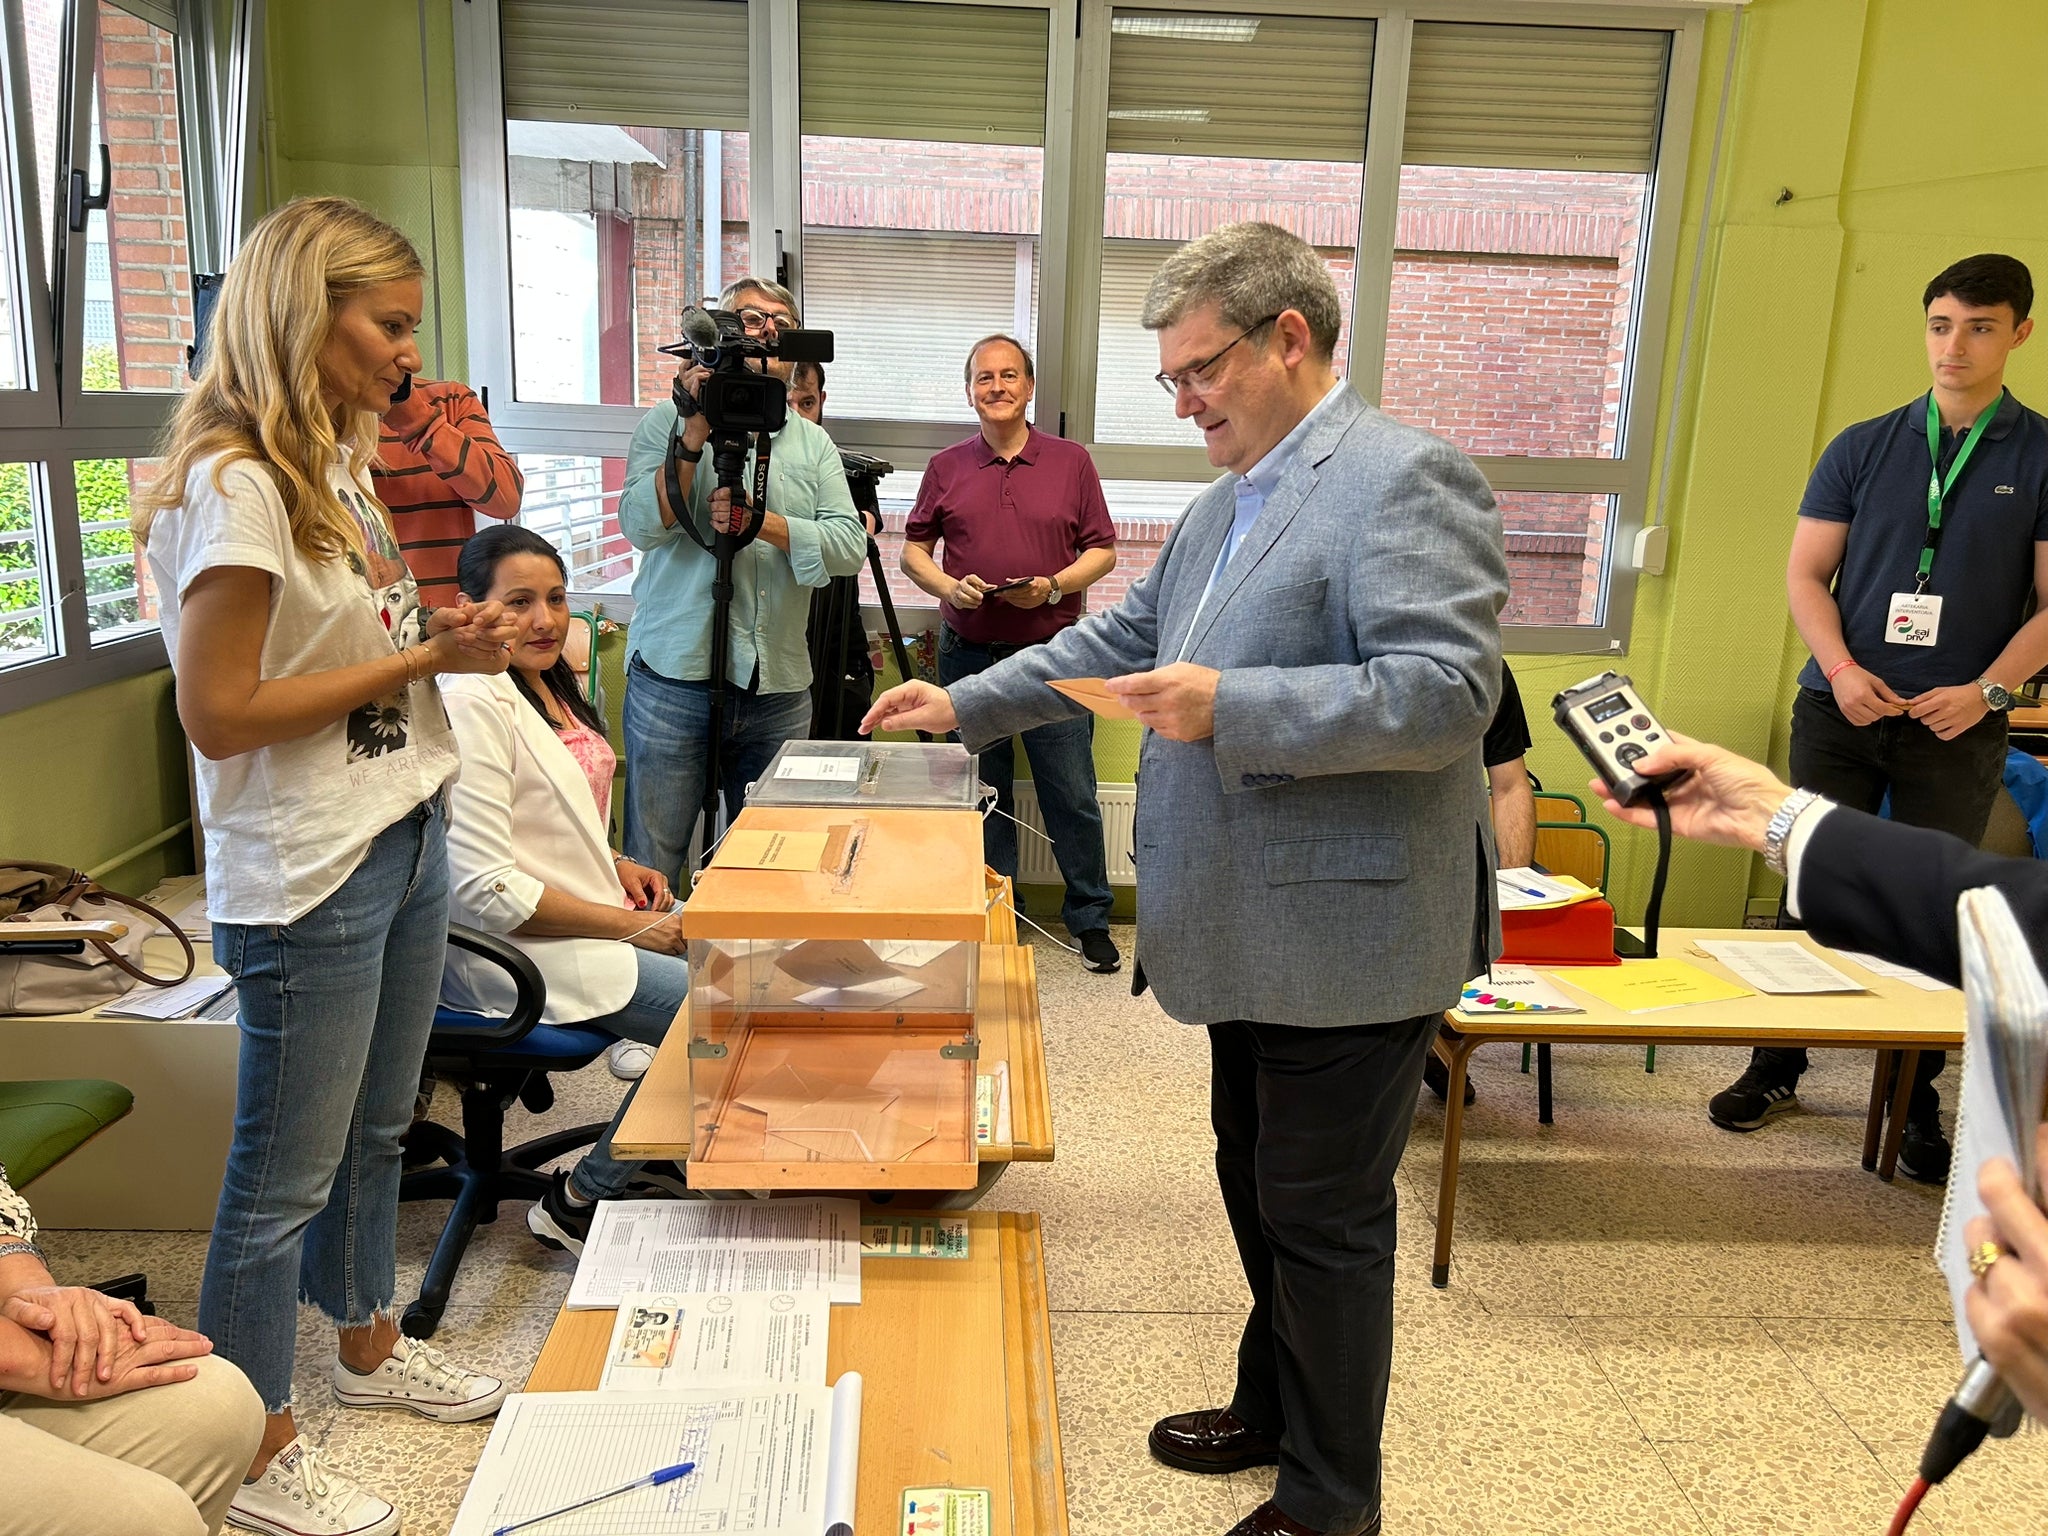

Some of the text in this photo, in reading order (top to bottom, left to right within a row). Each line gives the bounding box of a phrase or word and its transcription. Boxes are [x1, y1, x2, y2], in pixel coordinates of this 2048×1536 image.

[756, 463, 766, 502] SONY
[730, 505, 743, 533] YANG
[348, 768, 374, 788] WE
